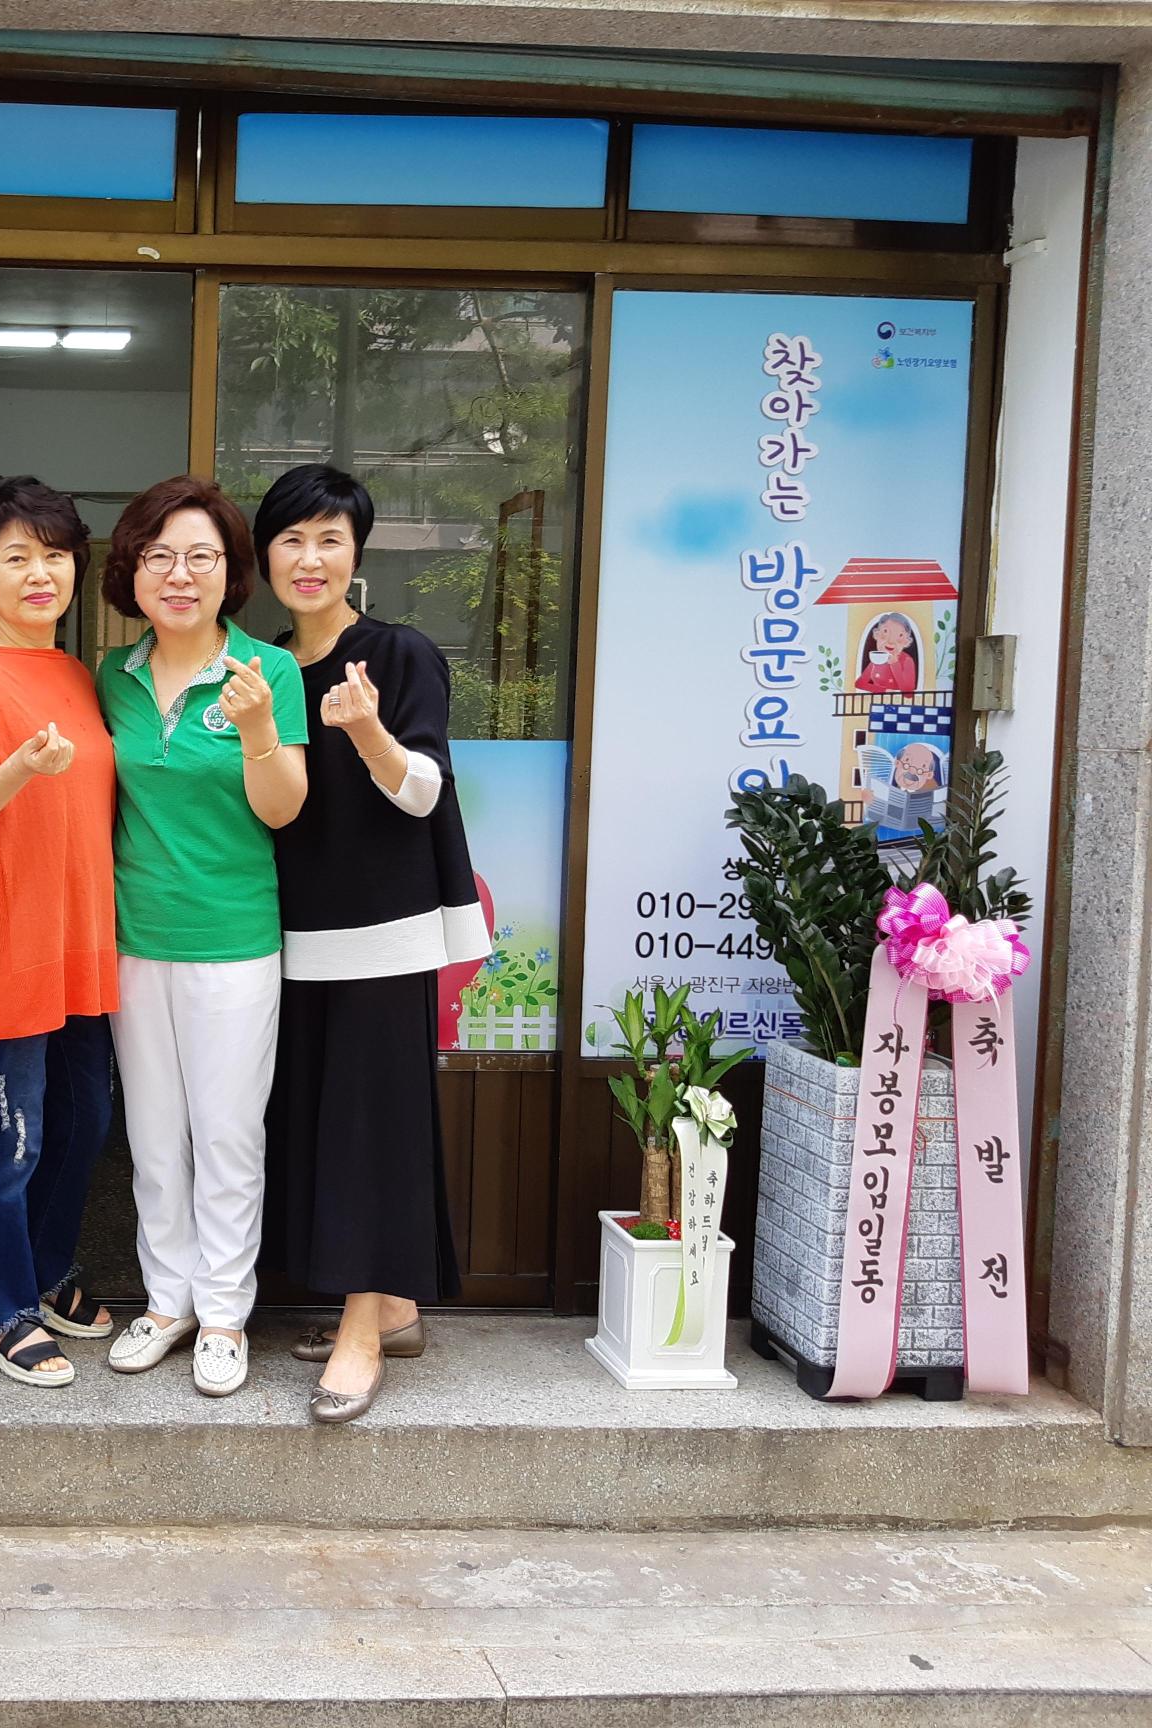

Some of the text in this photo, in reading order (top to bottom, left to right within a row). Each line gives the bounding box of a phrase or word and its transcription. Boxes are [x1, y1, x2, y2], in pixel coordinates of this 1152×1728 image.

[765, 337, 817, 517] 찾아가는
[631, 975, 683, 993] 서울시
[689, 975, 742, 994] 광진구
[851, 1023, 910, 1305] 자봉모임일동
